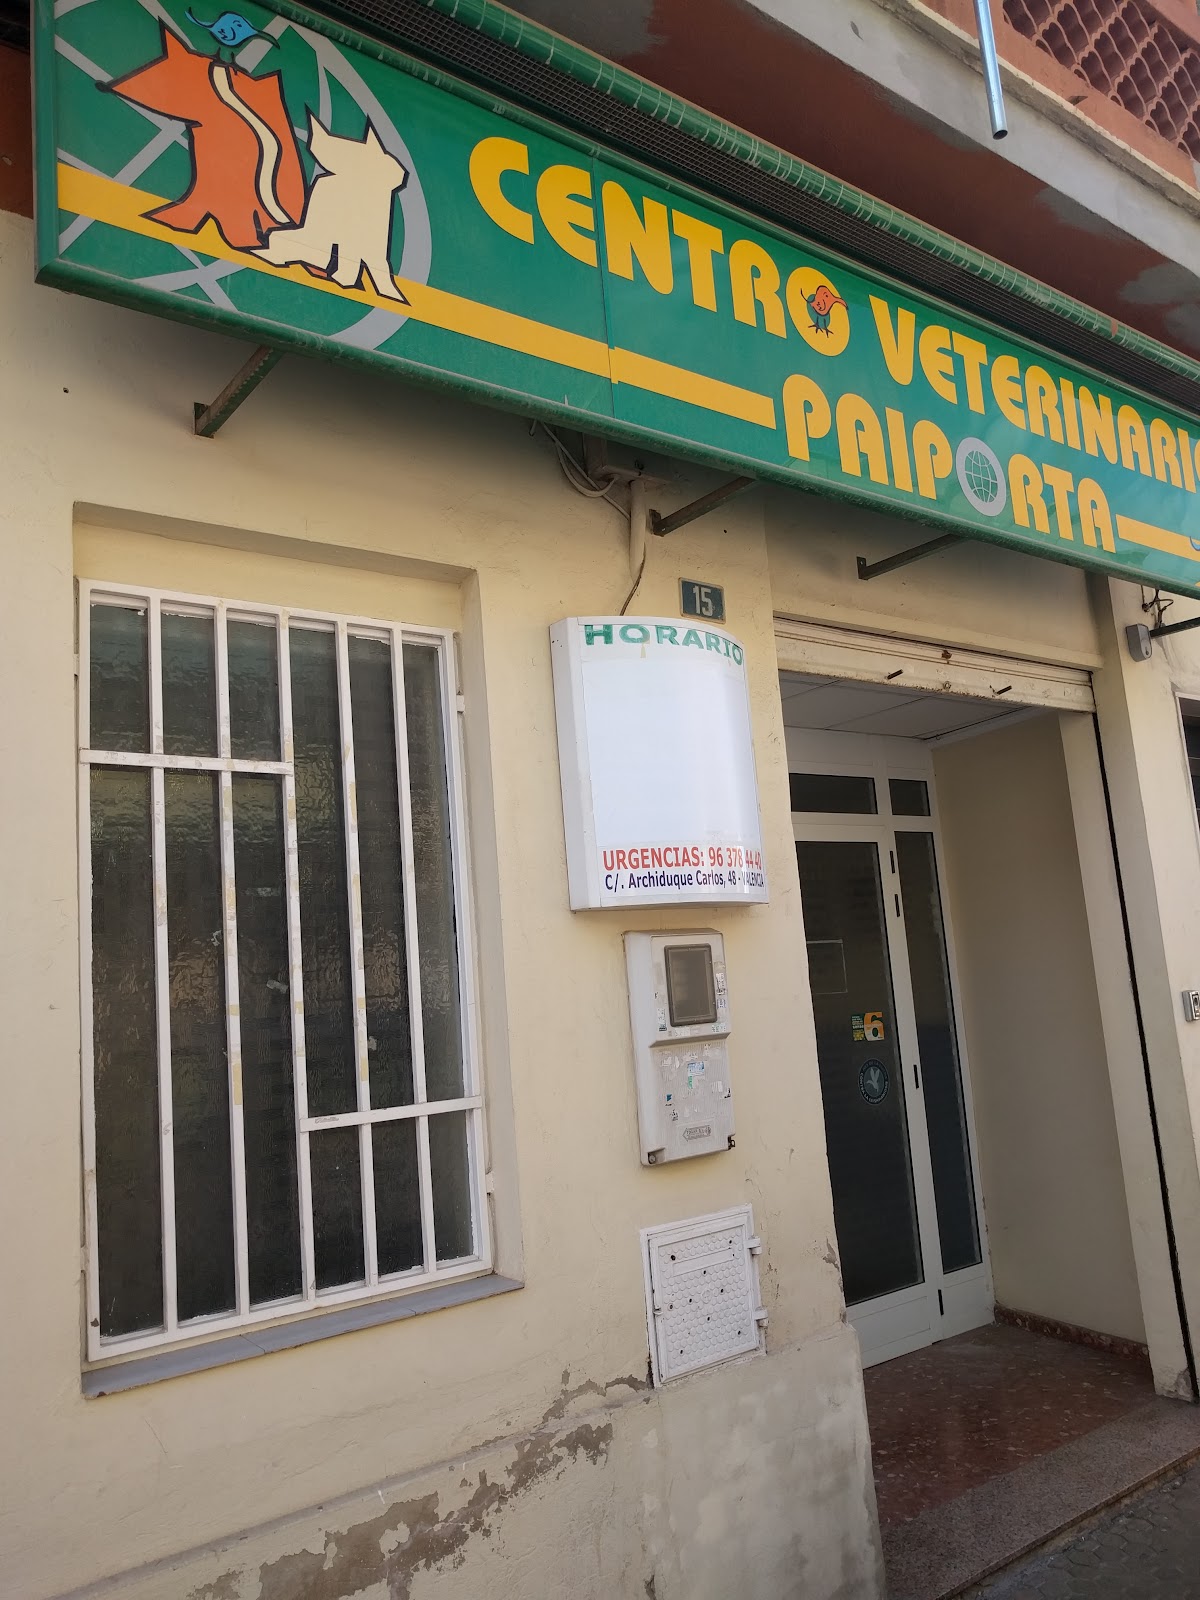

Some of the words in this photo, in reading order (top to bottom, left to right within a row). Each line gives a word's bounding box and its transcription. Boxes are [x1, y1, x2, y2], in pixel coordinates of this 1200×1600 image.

[469, 136, 850, 357] CENTRO
[869, 294, 1200, 494] VETERINARI
[782, 373, 1116, 554] PAIPORTA
[692, 585, 713, 617] 15
[584, 624, 743, 666] HORARIO
[603, 846, 705, 871] URGENCIAS:
[708, 846, 724, 868] 96
[727, 847, 744, 868] 378
[745, 850, 754, 869] 44
[605, 873, 624, 893] C/.
[628, 870, 694, 890] Archiduque
[695, 869, 726, 888] Carlos,
[728, 870, 737, 886] 48
